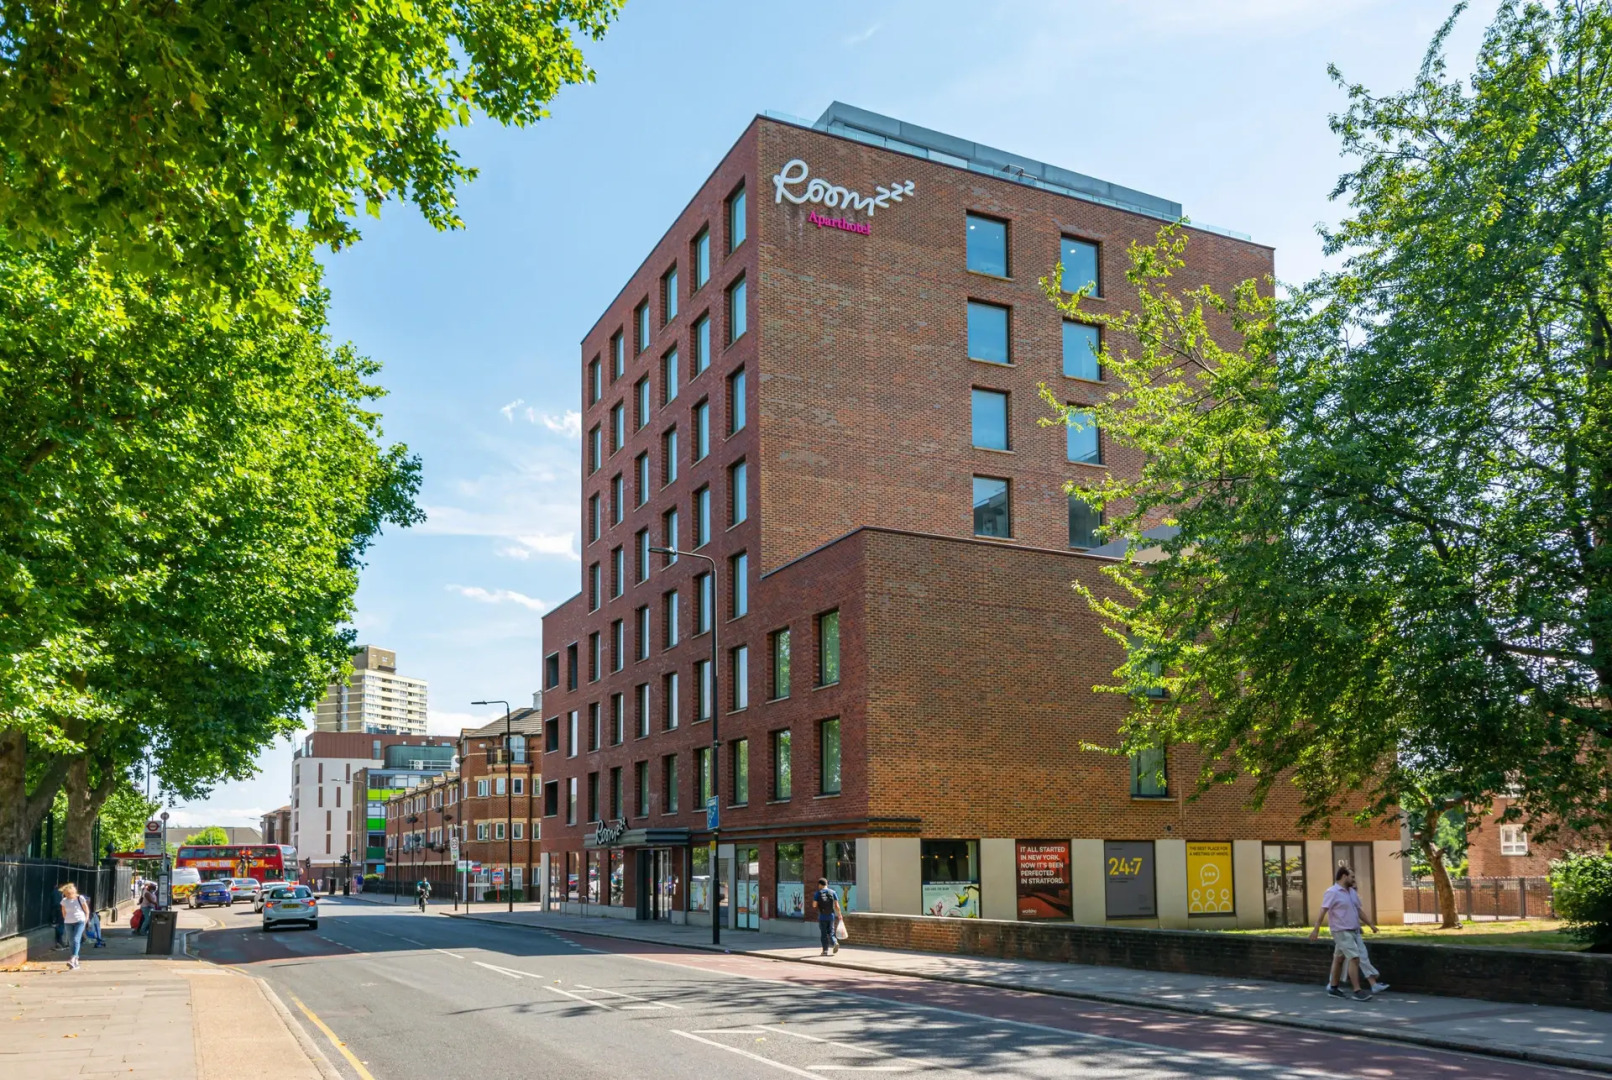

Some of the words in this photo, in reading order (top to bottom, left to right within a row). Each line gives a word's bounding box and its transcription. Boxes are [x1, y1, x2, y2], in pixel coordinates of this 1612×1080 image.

[773, 159, 915, 216] Roomzzz
[807, 210, 872, 236] Aparthotel
[1108, 857, 1143, 876] 24:7
